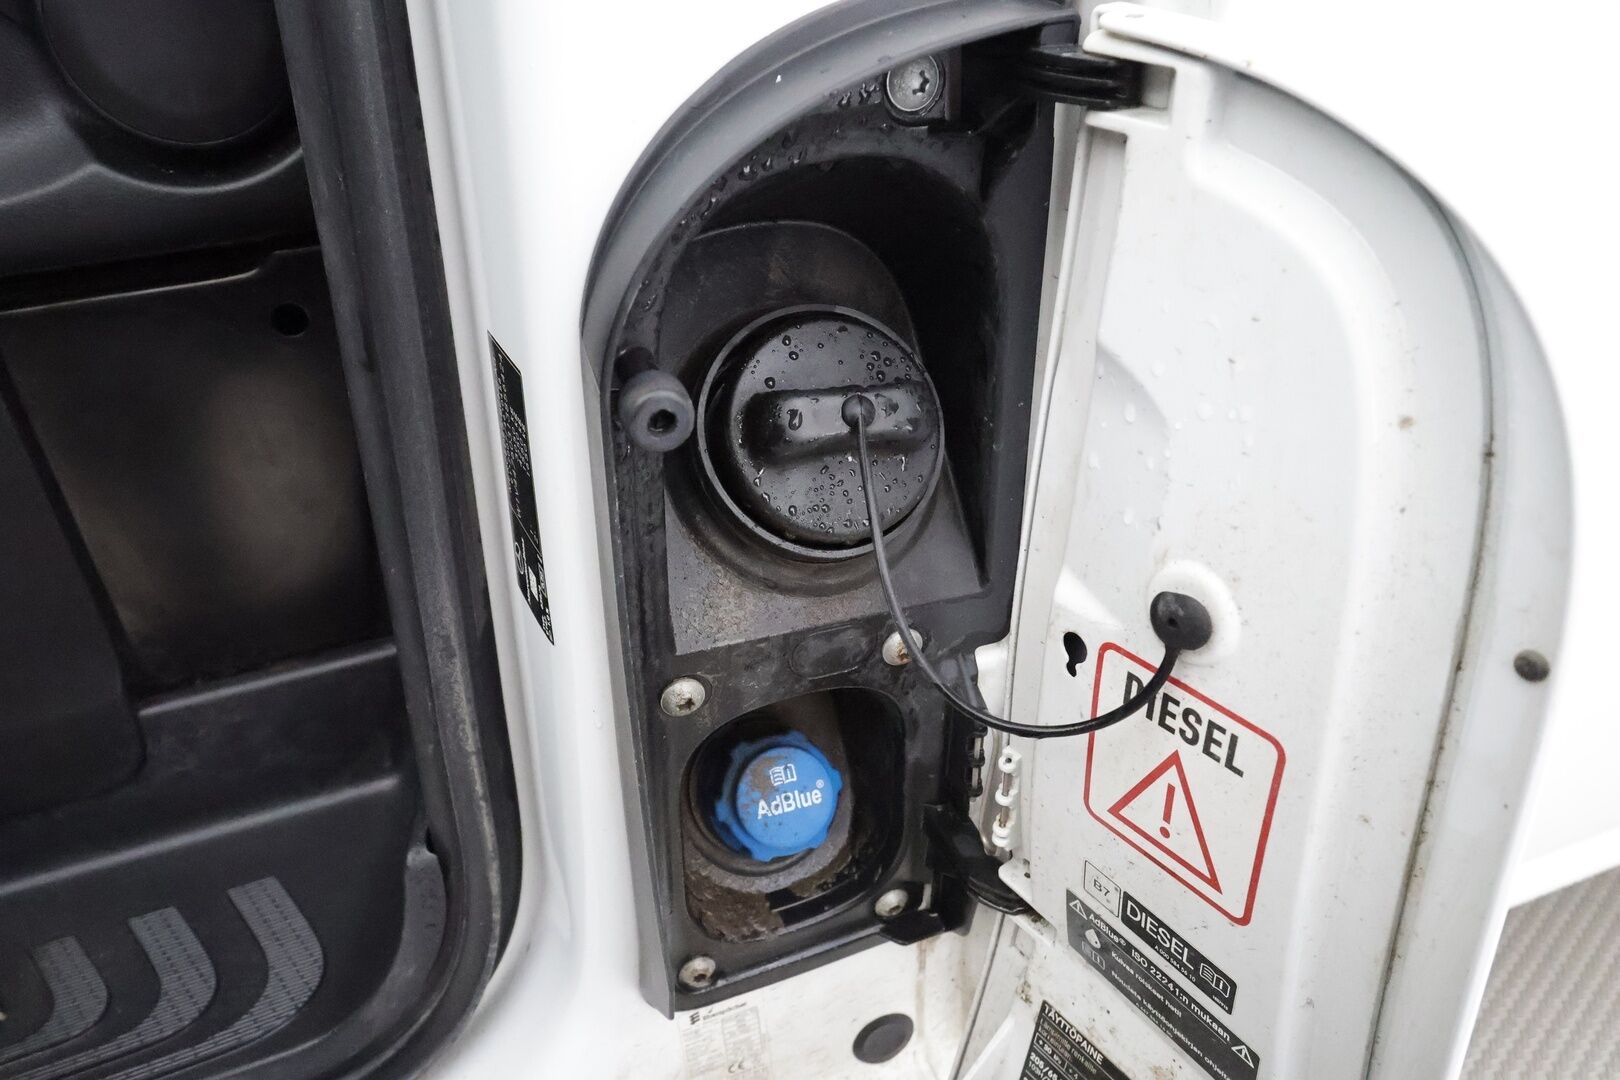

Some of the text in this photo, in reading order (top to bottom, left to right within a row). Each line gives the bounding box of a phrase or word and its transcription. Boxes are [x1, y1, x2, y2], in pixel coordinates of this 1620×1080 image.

[1123, 671, 1244, 778] DIESEL
[1093, 879, 1110, 896] B7
[1126, 899, 1194, 971] DIESEL
[1131, 949, 1148, 968] ISO
[1150, 965, 1189, 1005] 22241:n
[1191, 1003, 1231, 1042] mukaan
[1044, 1003, 1104, 1065] TÄYTTÖPAINE
